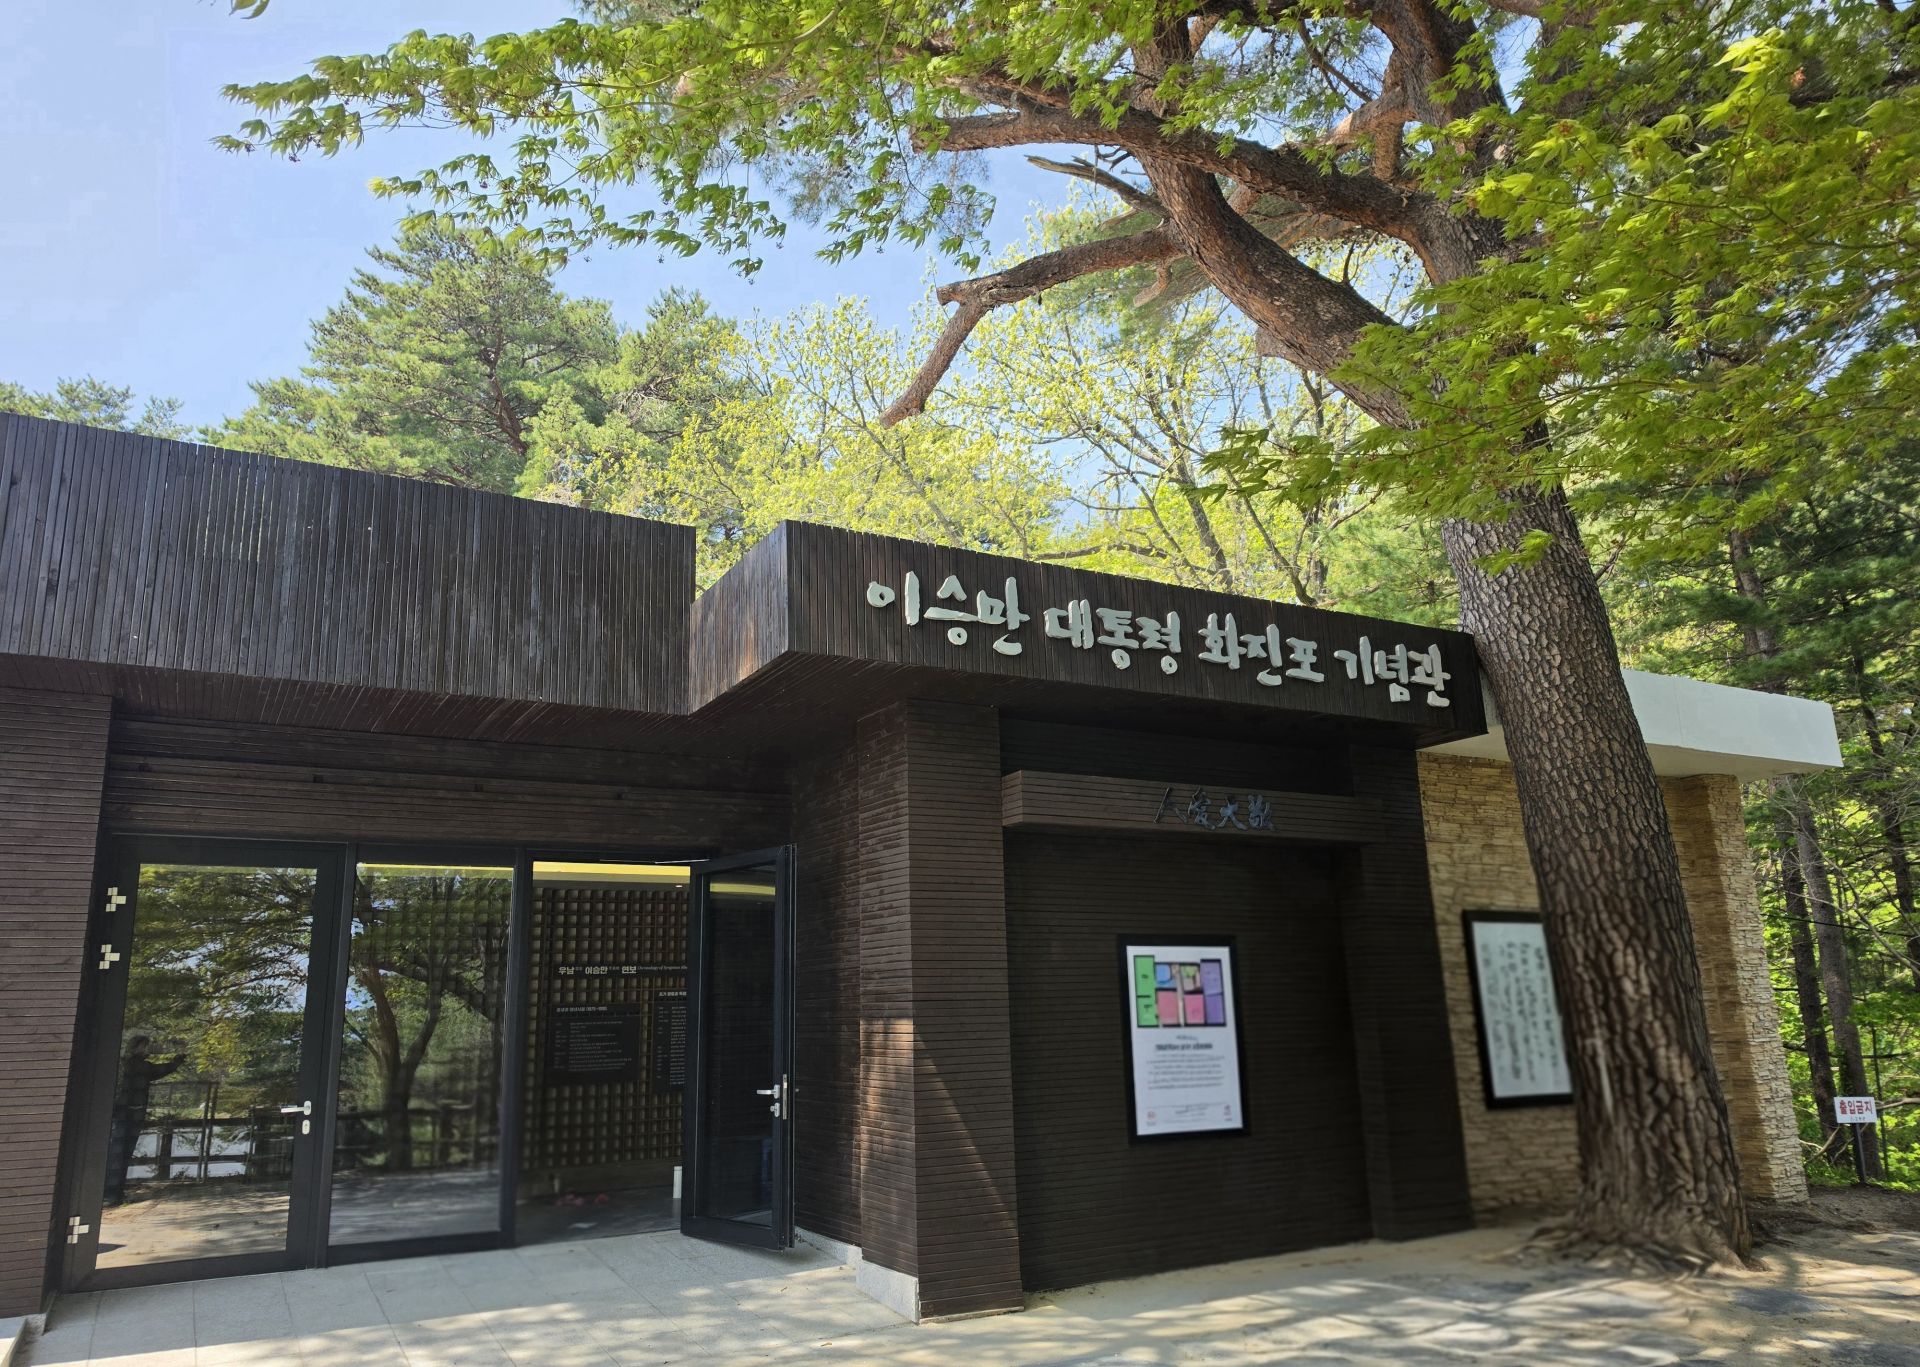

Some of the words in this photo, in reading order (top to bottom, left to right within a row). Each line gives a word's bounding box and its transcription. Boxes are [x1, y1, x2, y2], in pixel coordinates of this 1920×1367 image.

[867, 570, 1030, 656] 이승만
[1044, 599, 1182, 675] 대통령
[1199, 612, 1325, 686] 화진포
[1334, 635, 1452, 708] 기념관
[558, 966, 575, 975] 우남
[585, 966, 608, 975] 이승만
[621, 965, 637, 974] 연보
[1839, 1100, 1873, 1115] 출입금지
